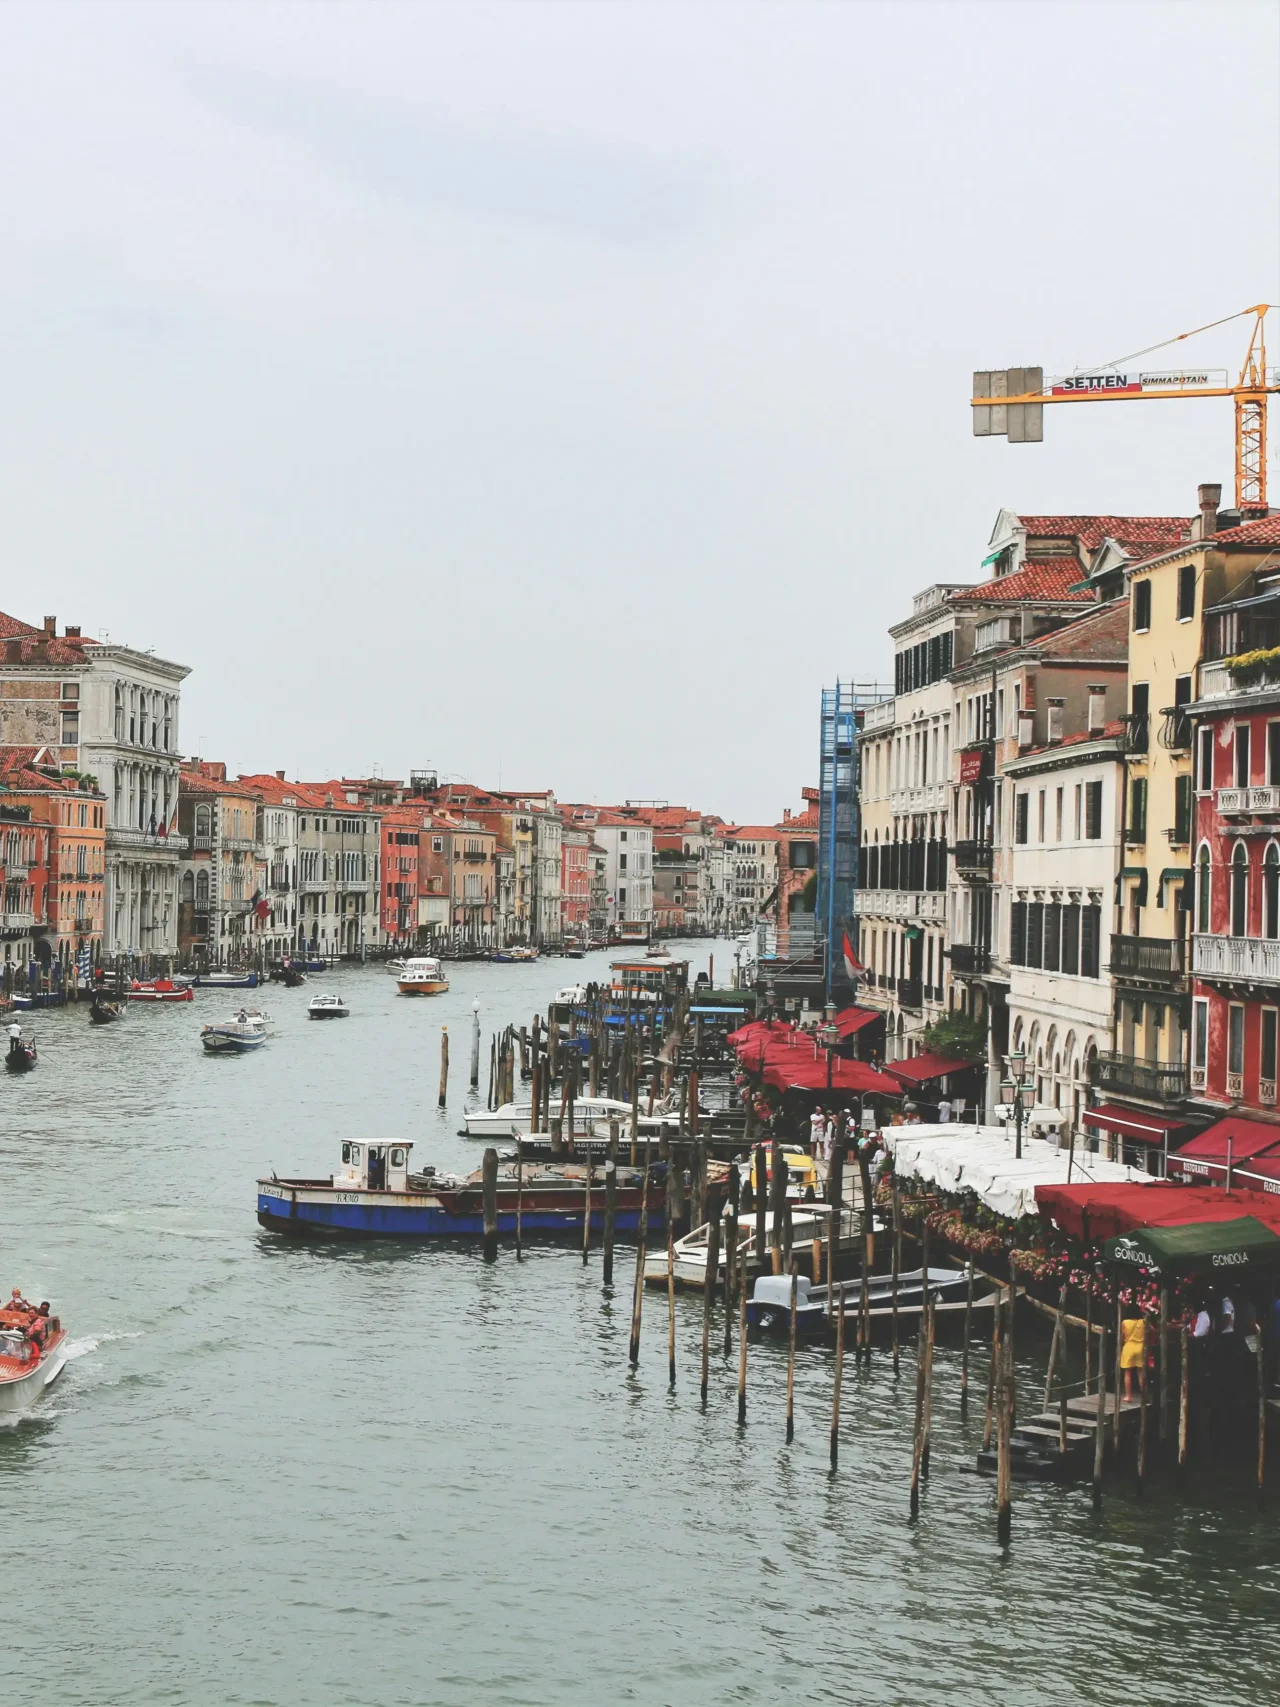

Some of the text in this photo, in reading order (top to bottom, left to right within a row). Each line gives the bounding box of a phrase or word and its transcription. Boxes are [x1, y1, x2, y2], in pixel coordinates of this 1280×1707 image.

[1064, 375, 1127, 390] SETTEN
[1183, 1162, 1209, 1176] RISTORANTE
[1114, 1246, 1154, 1266] GONDOLA
[1212, 1251, 1249, 1266] GONDOLA
